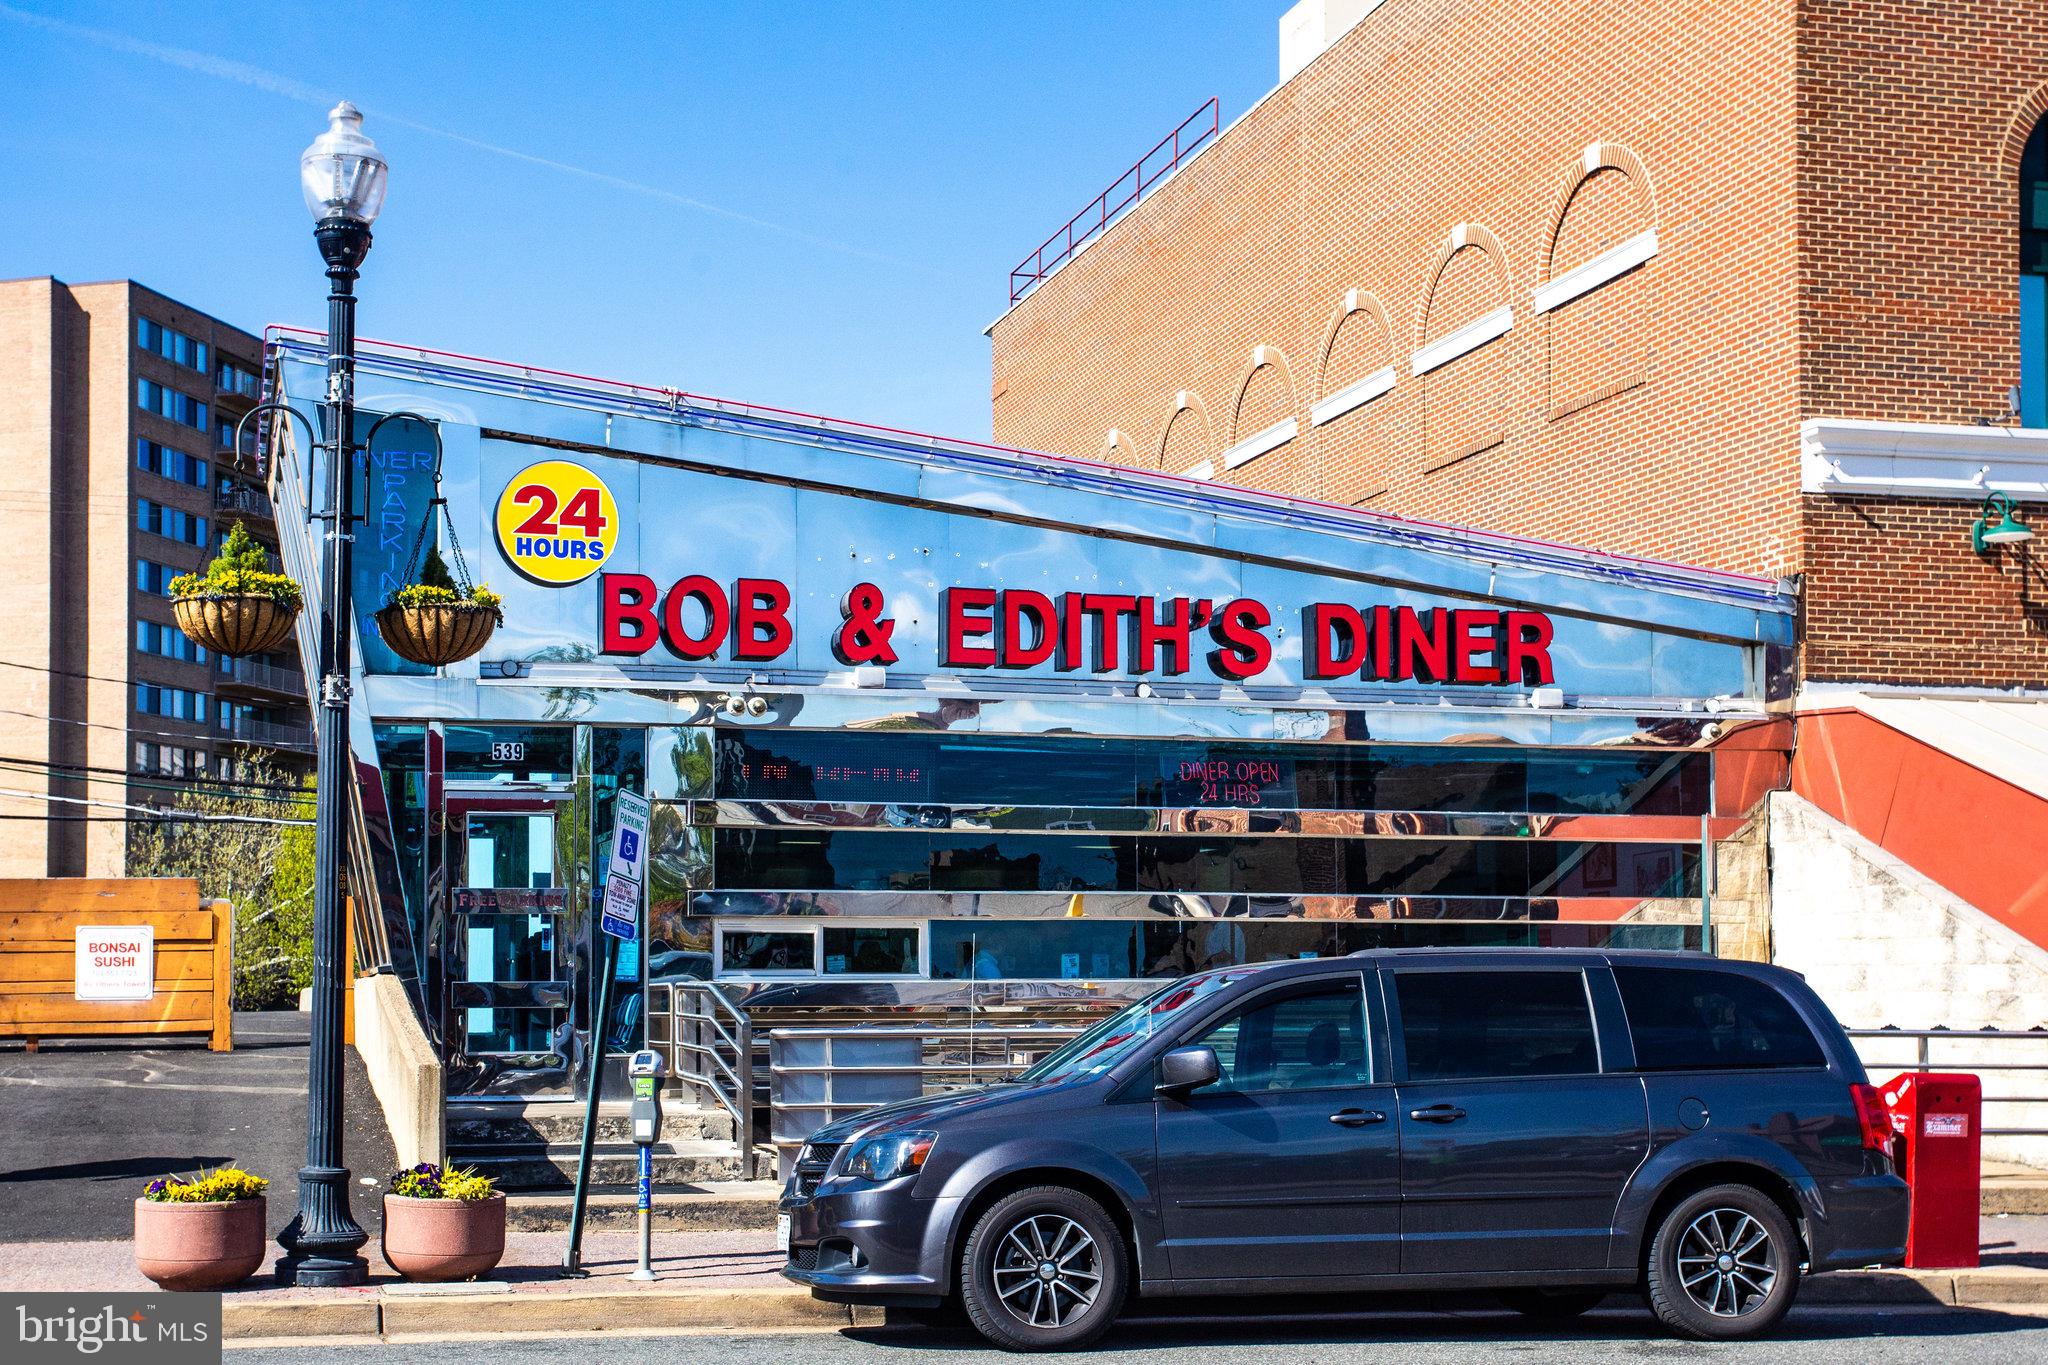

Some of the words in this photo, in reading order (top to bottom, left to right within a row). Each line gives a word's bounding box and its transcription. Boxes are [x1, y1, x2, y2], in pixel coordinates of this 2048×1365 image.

[353, 452, 432, 470] INER
[513, 485, 606, 537] 24
[516, 537, 604, 560] HOURS
[598, 573, 793, 661] BOB
[832, 582, 899, 666] &
[938, 586, 1271, 681] EDITH'S
[1302, 603, 1555, 687] DINER
[493, 743, 524, 760] 539
[1181, 762, 1229, 781] DINER
[1237, 762, 1279, 782] OPEN
[1200, 781, 1218, 802] 24
[1225, 784, 1260, 804] HRS
[620, 798, 647, 817] RESERVED
[620, 812, 645, 831] PARKING
[459, 894, 496, 906] FREE
[89, 942, 141, 953] BONSAI
[94, 956, 135, 967] SUSHI
